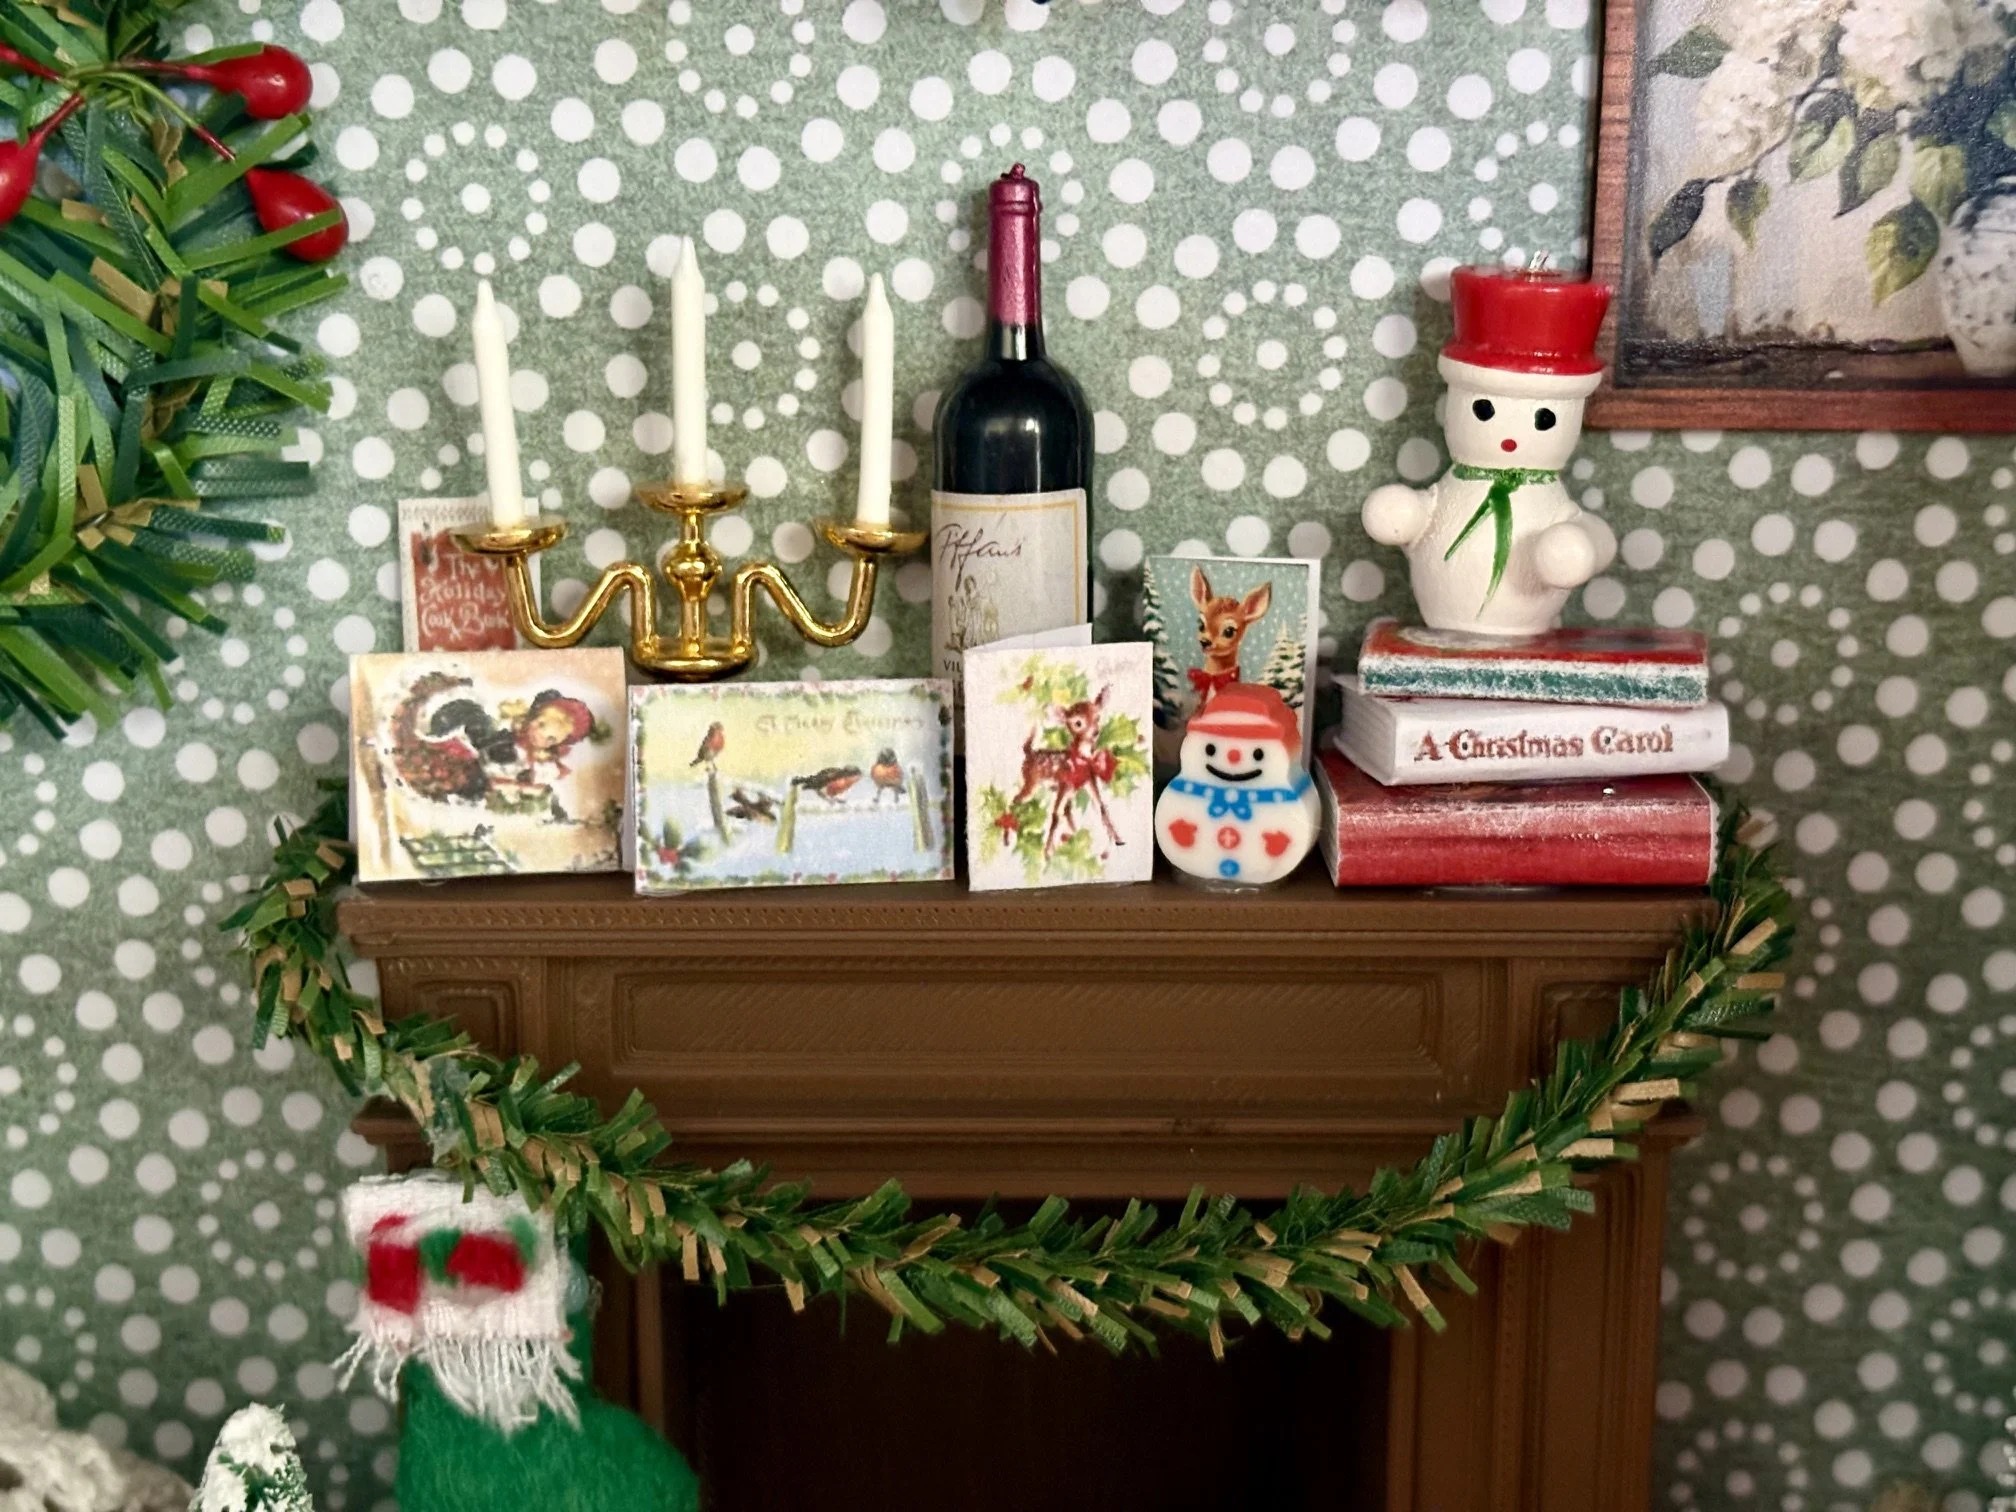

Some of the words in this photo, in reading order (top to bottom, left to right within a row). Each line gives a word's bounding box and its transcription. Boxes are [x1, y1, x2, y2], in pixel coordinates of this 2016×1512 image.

[1414, 729, 1443, 762] A
[1446, 728, 1584, 760] Christmas
[1590, 723, 1674, 755] Carol
